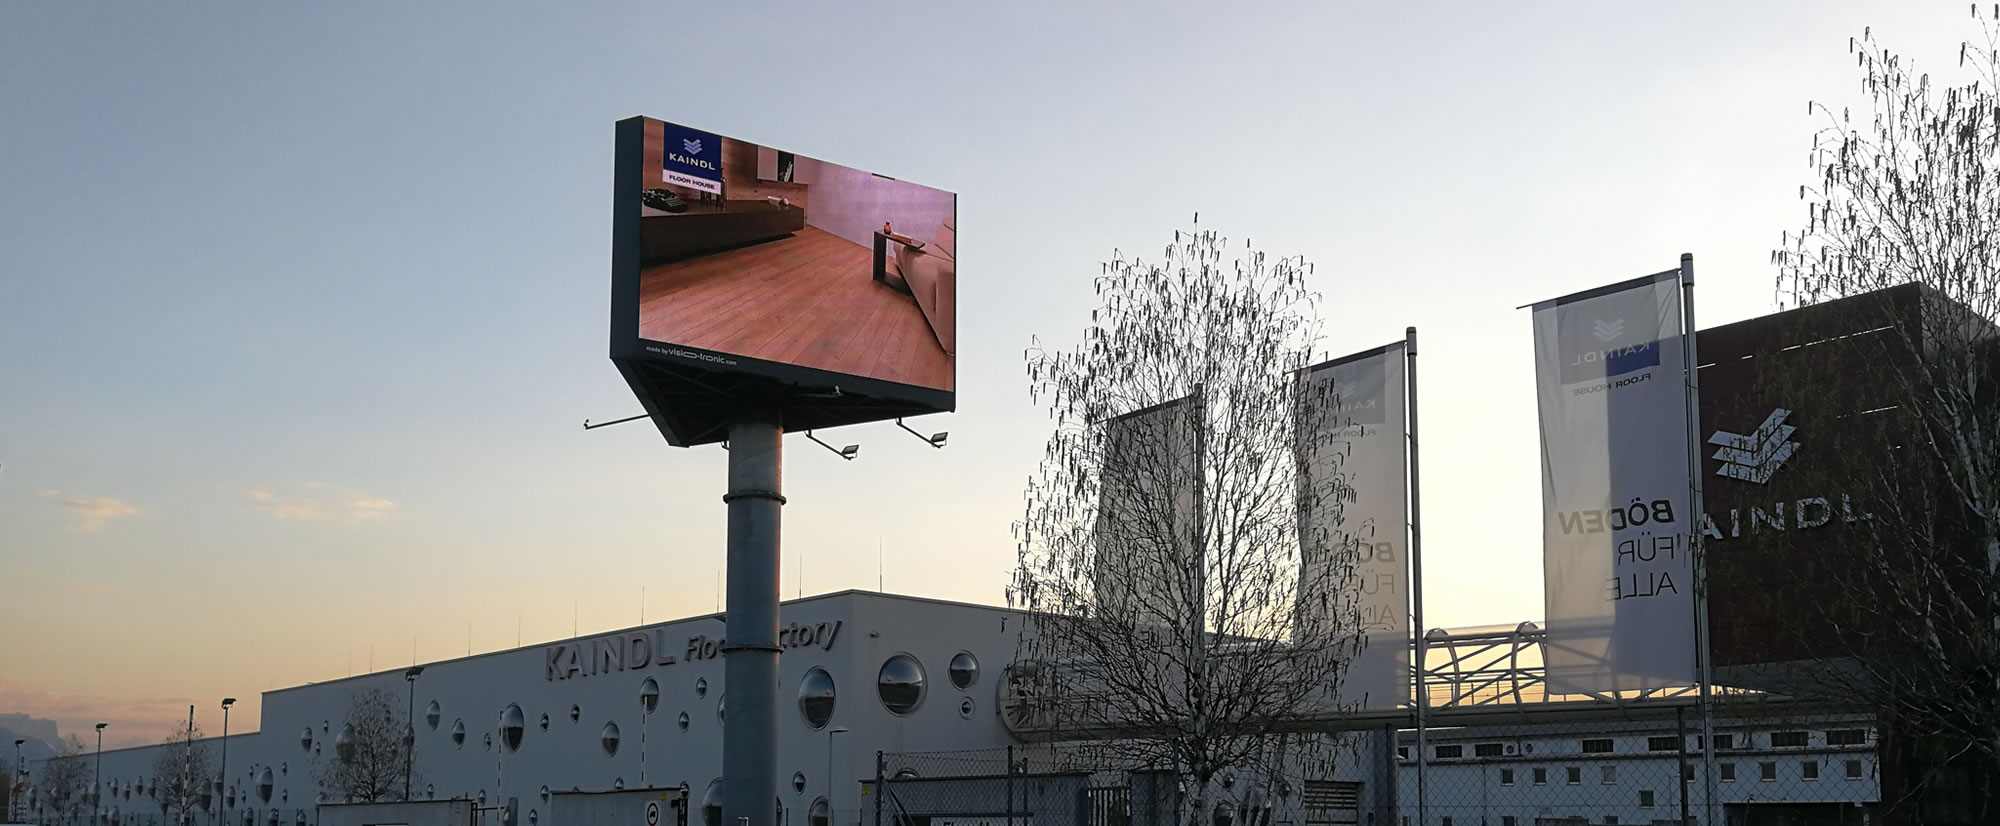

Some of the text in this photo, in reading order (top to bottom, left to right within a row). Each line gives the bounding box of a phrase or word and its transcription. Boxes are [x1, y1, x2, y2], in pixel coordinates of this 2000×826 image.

[669, 152, 716, 171] KAINDL
[669, 175, 715, 190] FLOOR HOUSE
[646, 345, 661, 353] made
[1702, 492, 1873, 540] AINDL
[545, 629, 676, 681] KAINDL
[779, 620, 843, 652] ctory
